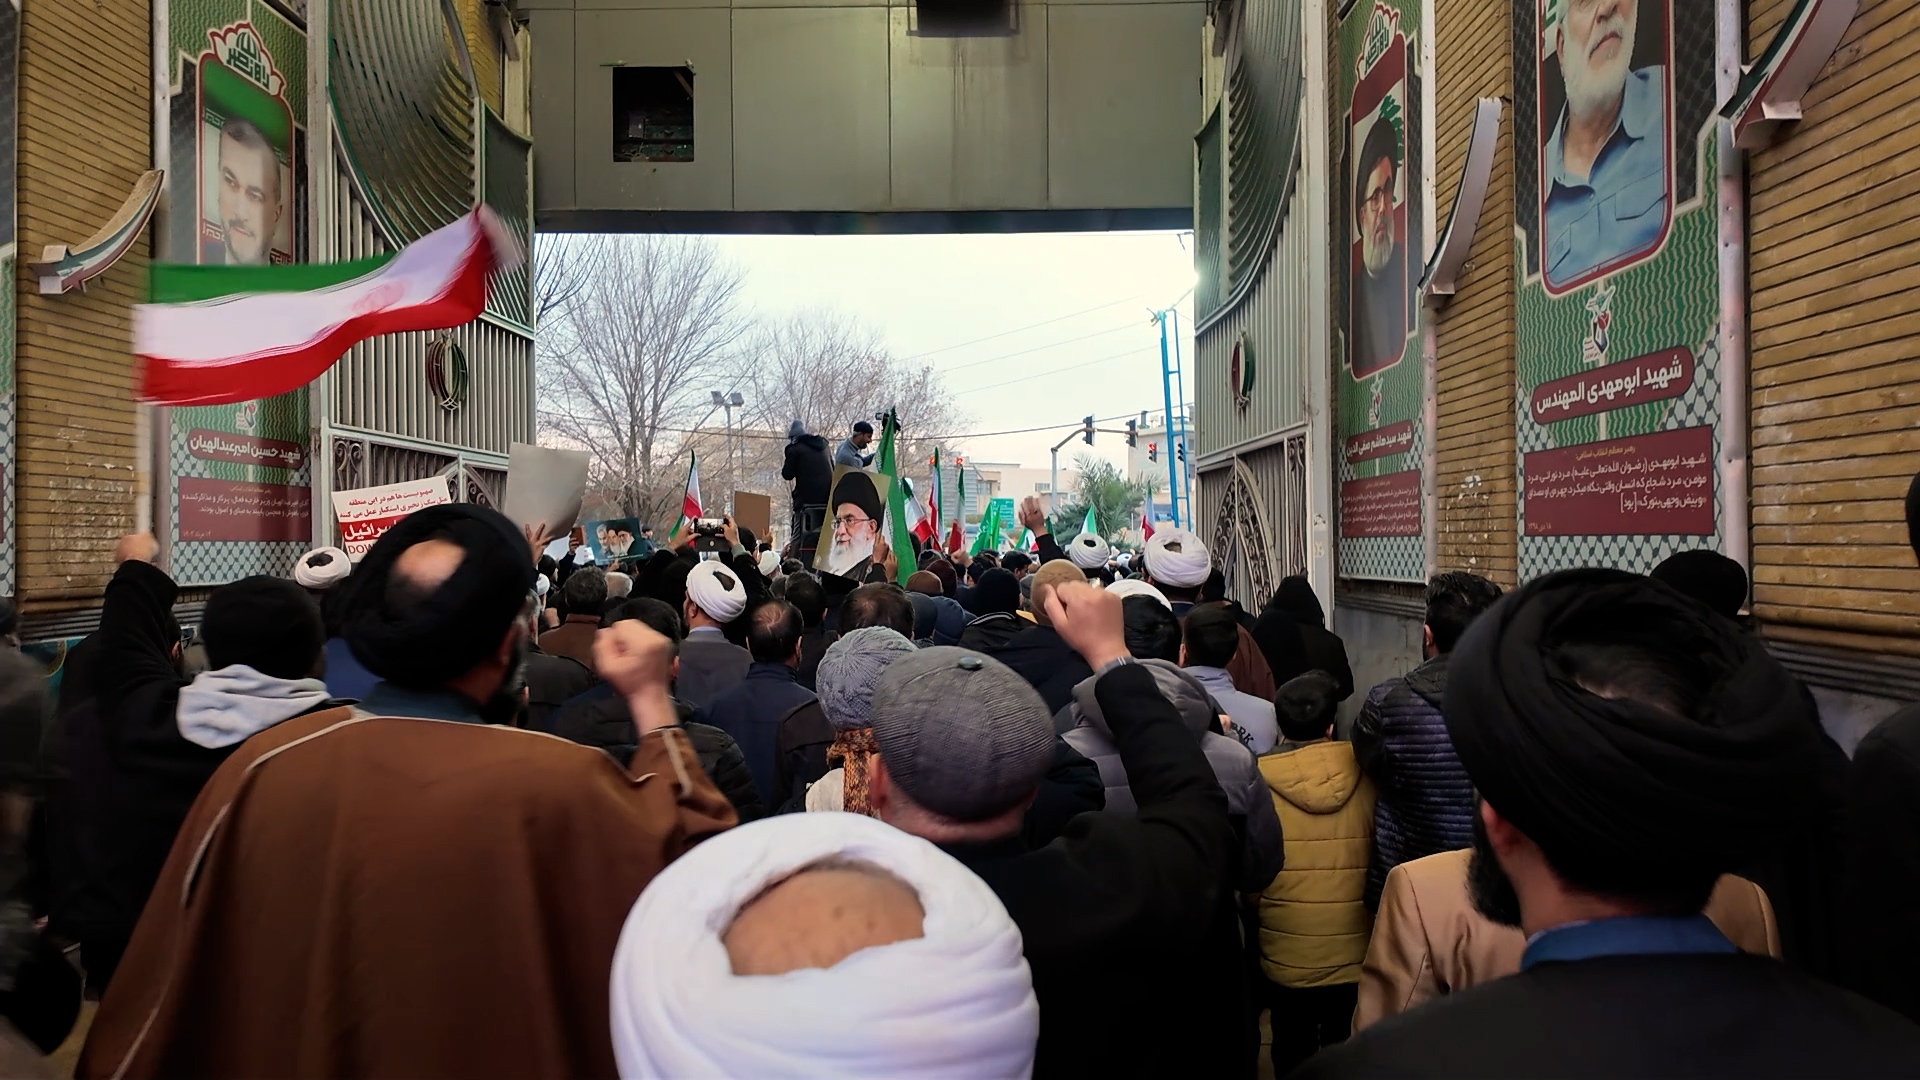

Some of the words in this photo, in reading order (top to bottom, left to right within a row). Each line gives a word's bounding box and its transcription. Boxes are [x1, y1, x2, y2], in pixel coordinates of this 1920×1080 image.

[1643, 354, 1683, 390] شهید
[1536, 381, 1585, 414] المهندس
[1397, 425, 1412, 445] شهید
[251, 445, 279, 459] حسین
[279, 446, 301, 464] شهید
[1680, 452, 1707, 469] شهید
